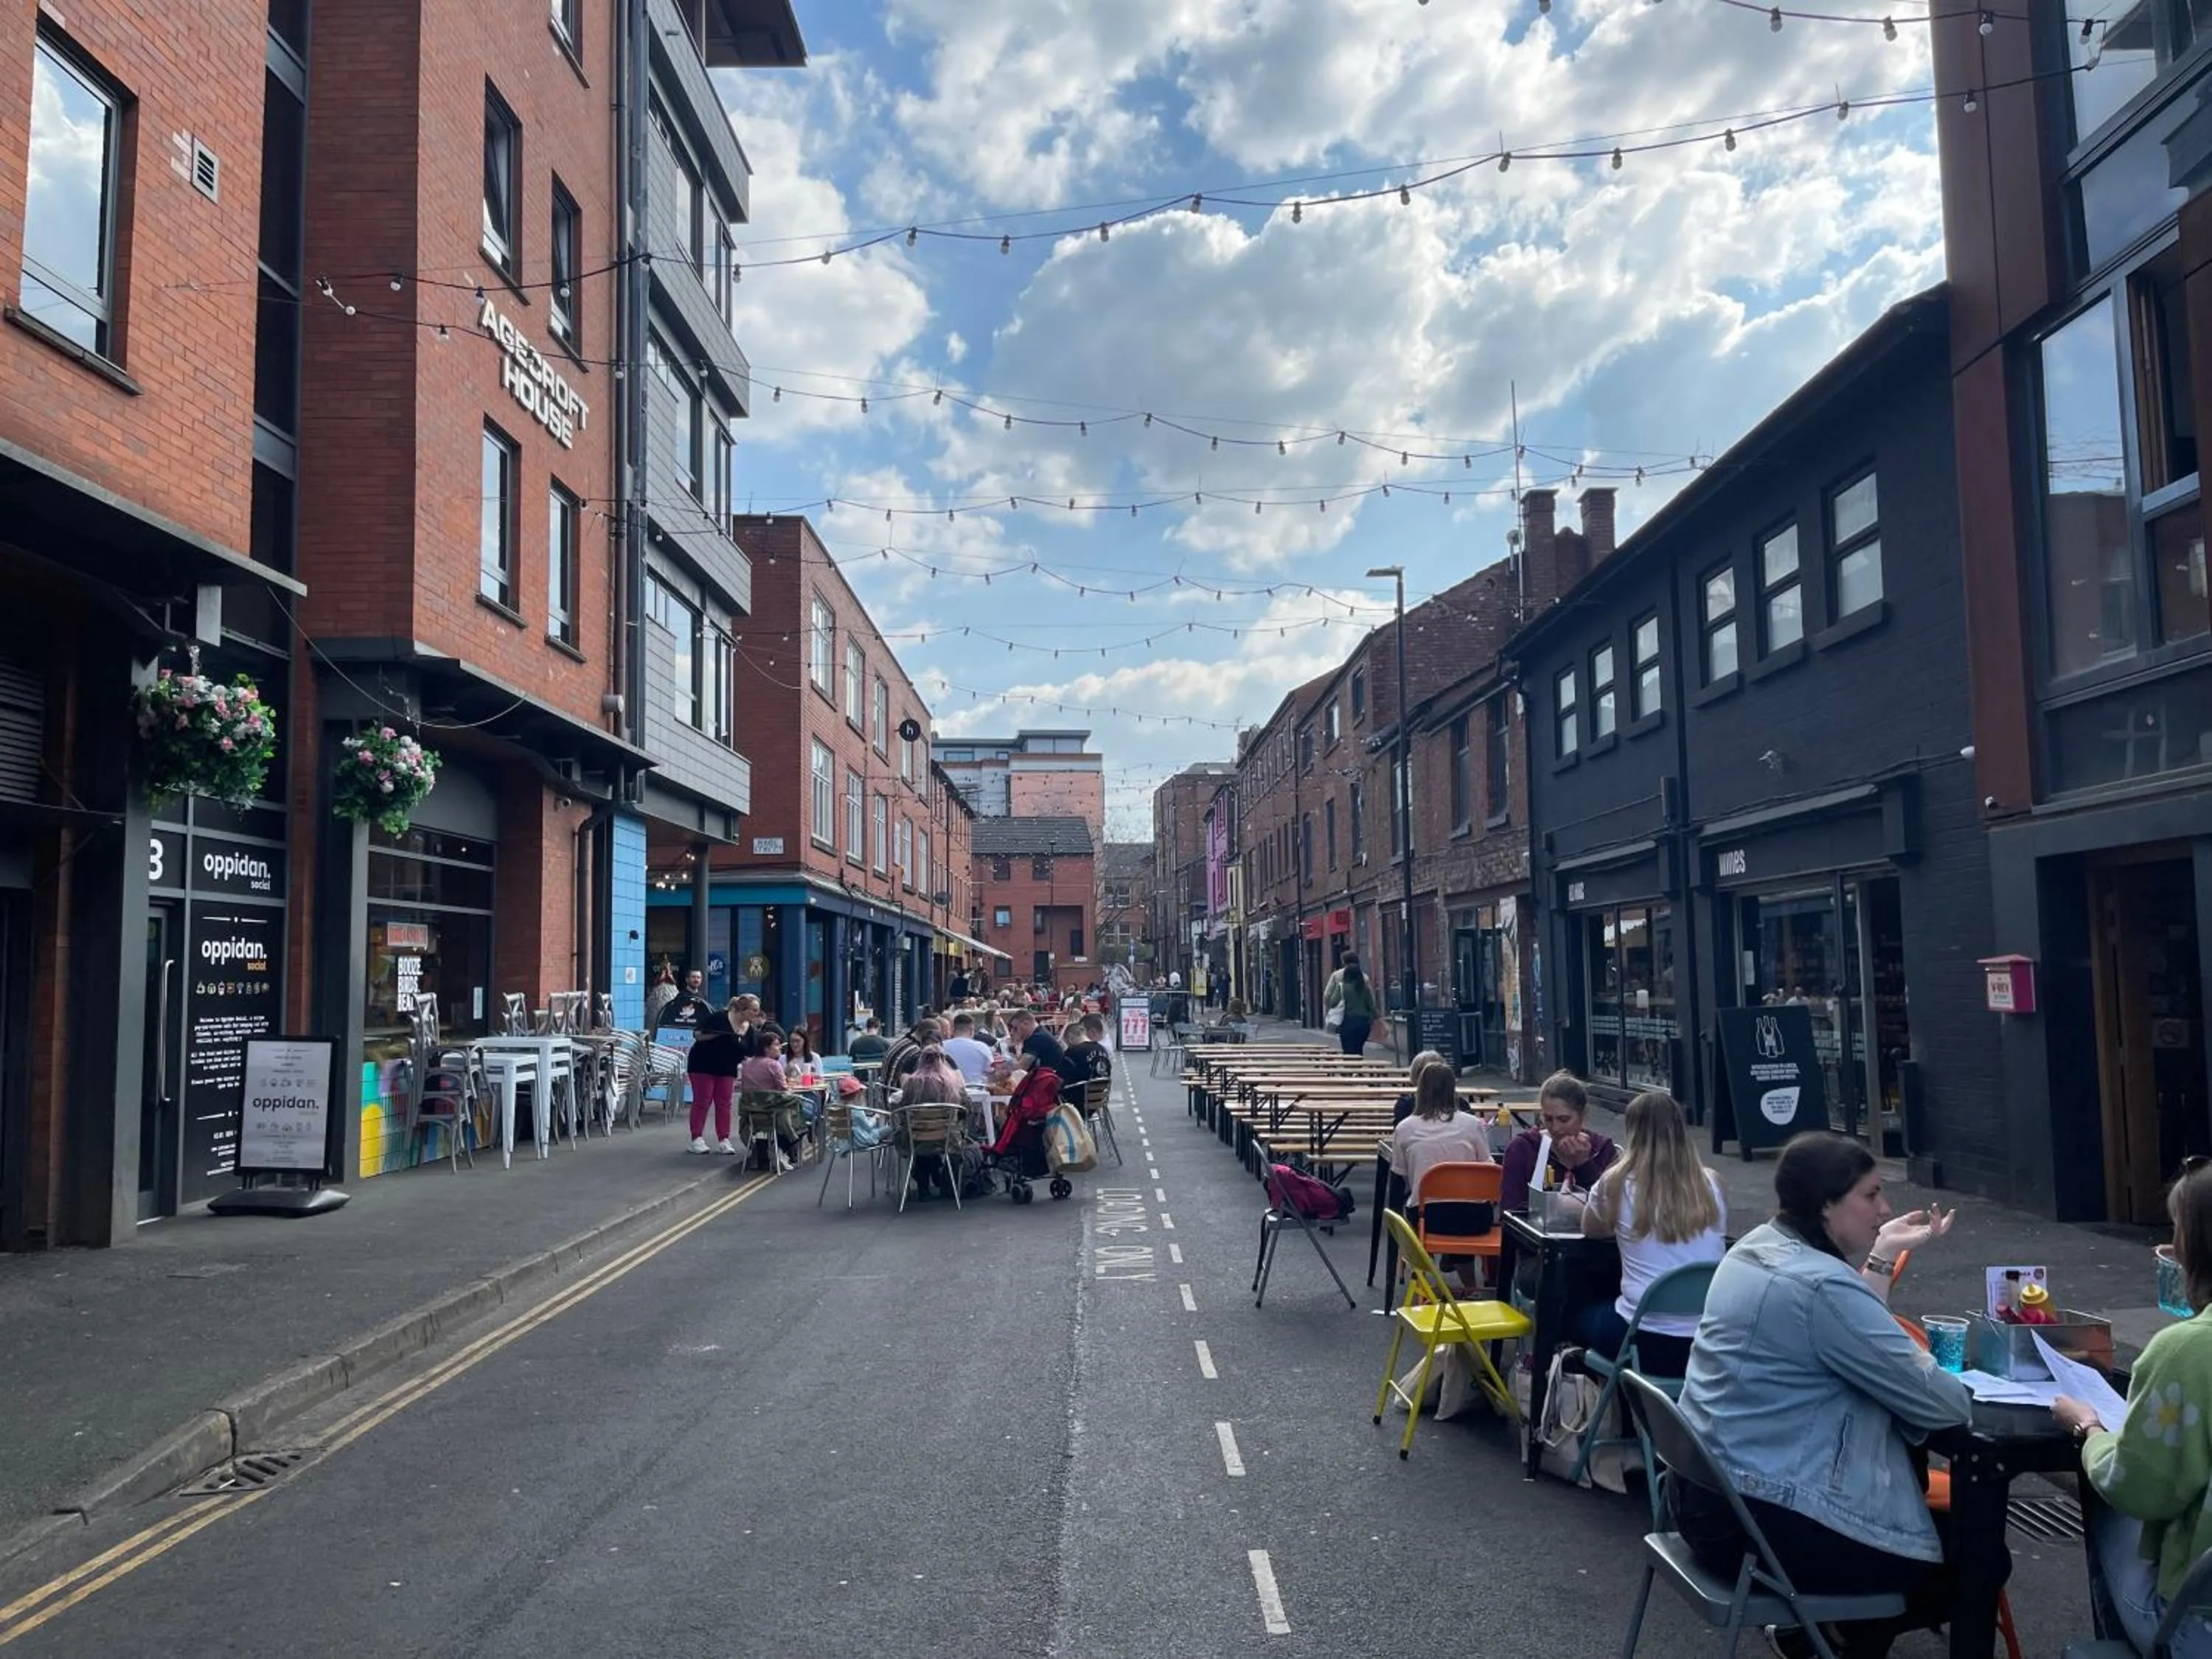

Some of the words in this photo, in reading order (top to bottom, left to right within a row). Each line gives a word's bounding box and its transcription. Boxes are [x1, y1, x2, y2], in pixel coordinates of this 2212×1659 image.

[481, 299, 589, 431] AGECROFT
[504, 355, 573, 450] HOUSE
[203, 852, 271, 880] oppidan.
[250, 880, 271, 891] social
[201, 936, 267, 965] oppidan.
[253, 1095, 319, 1112] oppidan.
[1096, 1188, 1147, 1237] LOADING
[1094, 1245, 1157, 1282] ONLY
